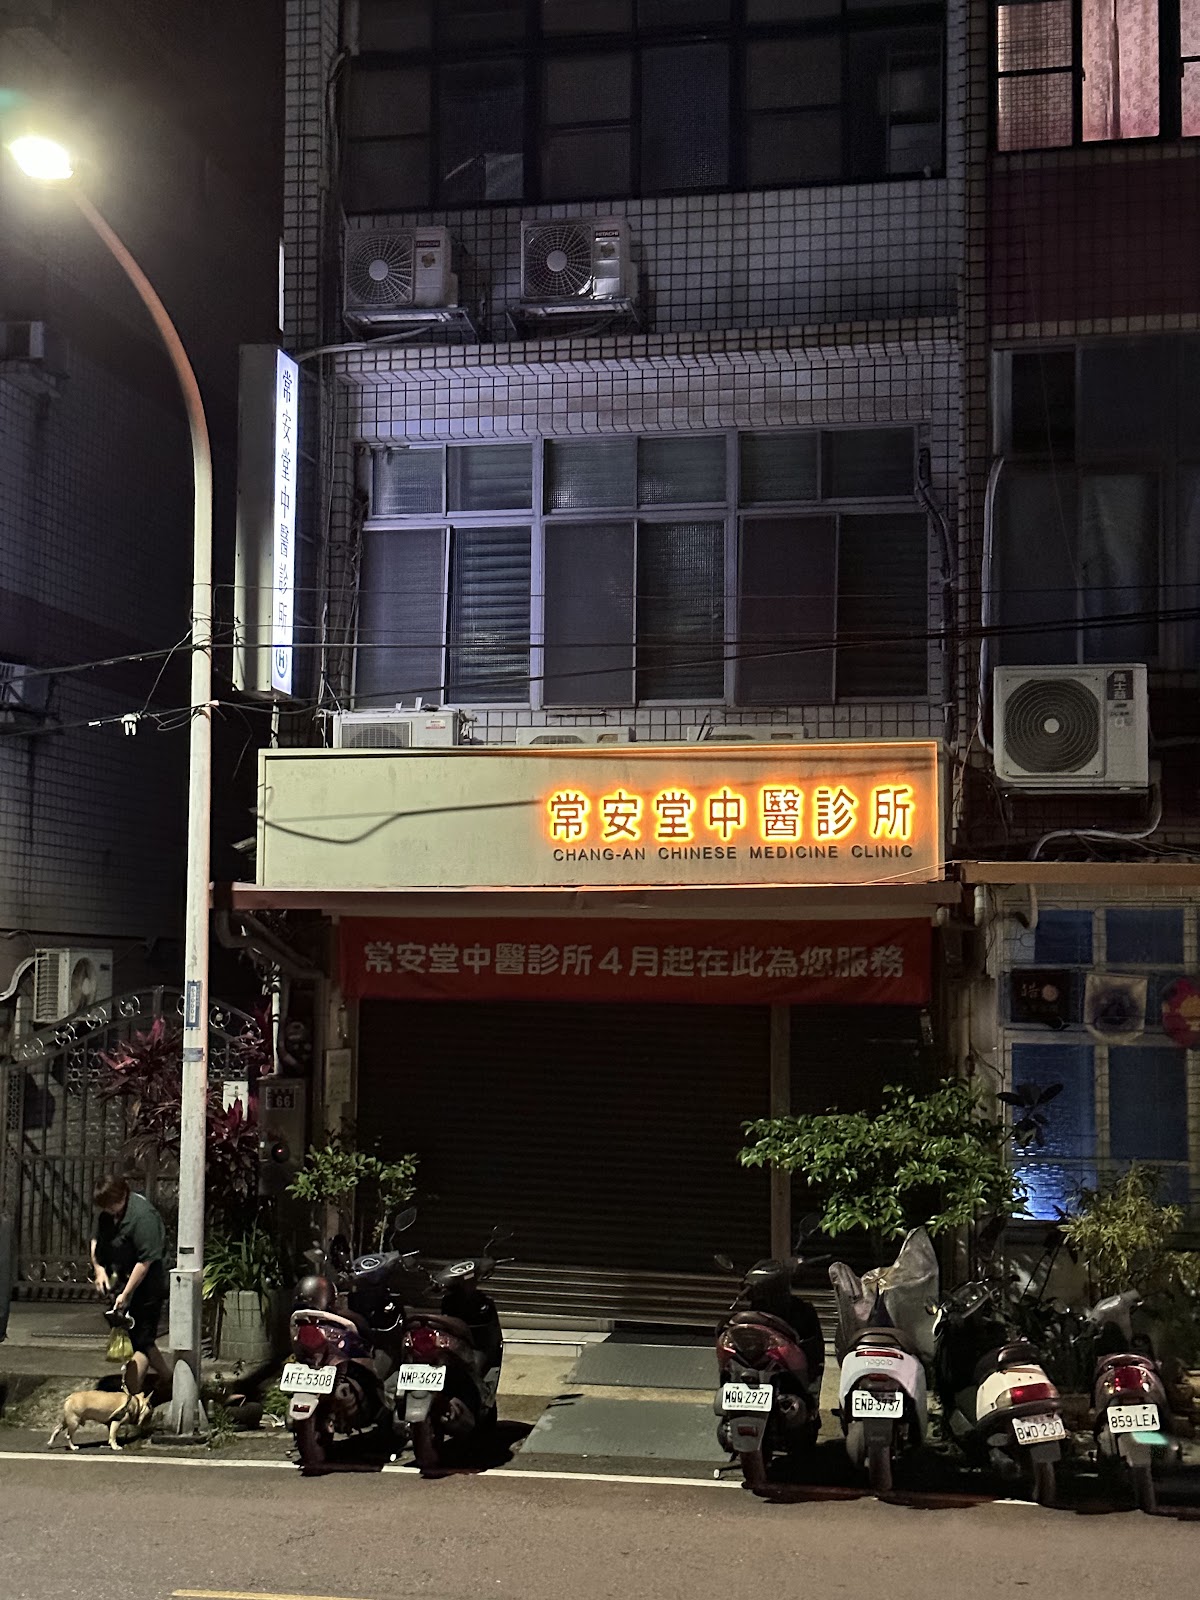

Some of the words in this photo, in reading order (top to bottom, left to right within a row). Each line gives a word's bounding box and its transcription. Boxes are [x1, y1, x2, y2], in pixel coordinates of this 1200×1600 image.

[551, 788, 911, 838] 常安堂中醫診所
[553, 848, 646, 861] CHANG-AN
[658, 846, 737, 860] CHINESE
[750, 845, 838, 859] MEDICINE
[851, 844, 913, 858] CLINIC
[364, 941, 904, 977] 常安堂中醫診所4月起在此為您服務
[283, 1372, 332, 1387] AFE-5308
[400, 1371, 443, 1385] NMP-3692
[1111, 1413, 1157, 1428] 859-LEA
